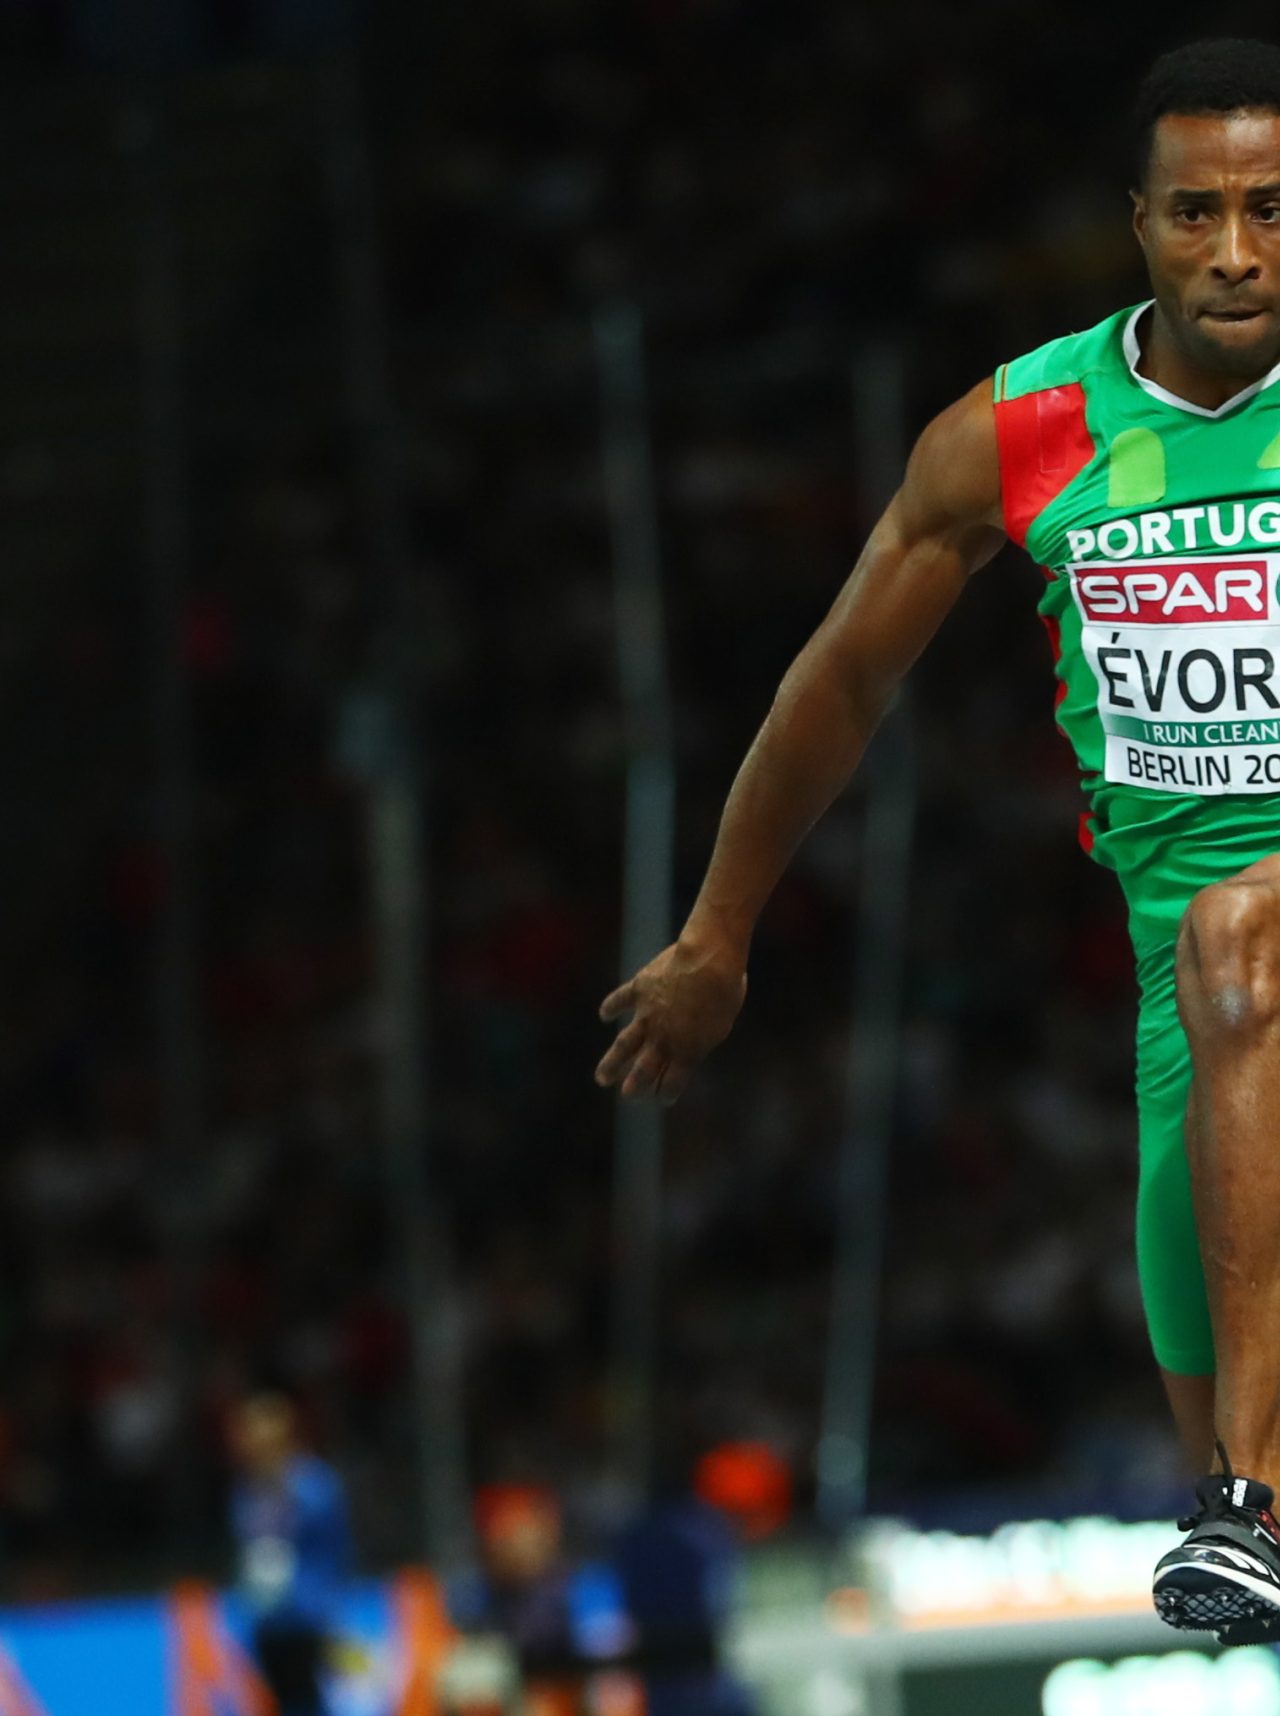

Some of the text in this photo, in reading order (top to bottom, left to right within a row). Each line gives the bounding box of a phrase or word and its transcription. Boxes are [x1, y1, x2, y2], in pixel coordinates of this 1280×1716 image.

[1081, 569, 1264, 616] SPAR
[1152, 724, 1197, 744] RUN
[1127, 746, 1231, 786] BERLIN
